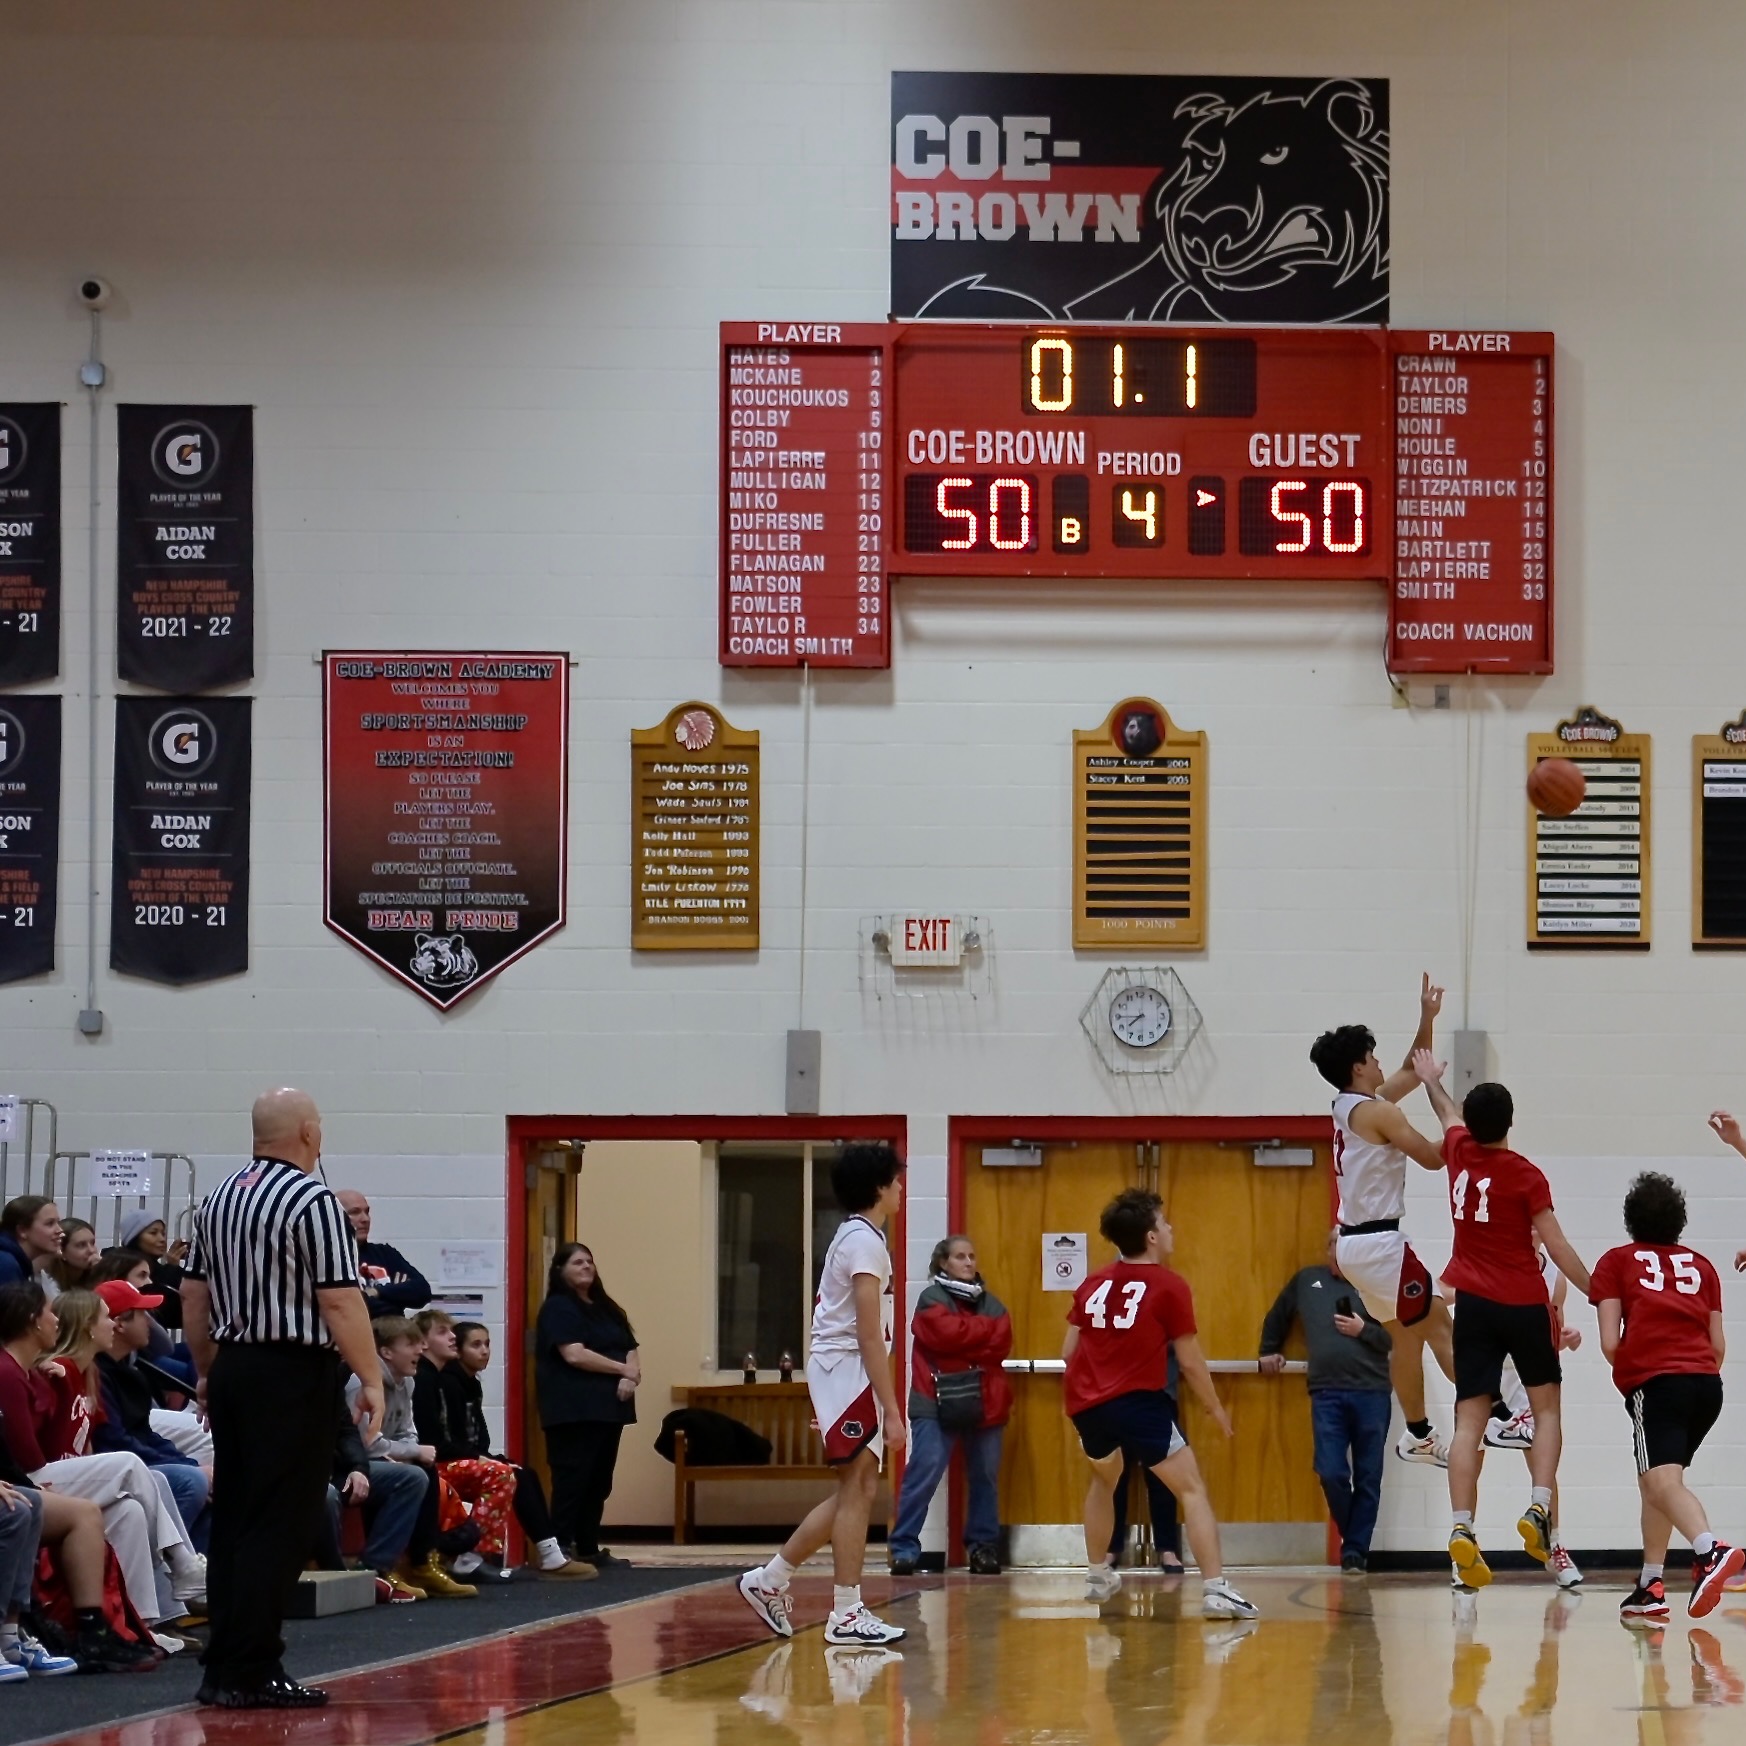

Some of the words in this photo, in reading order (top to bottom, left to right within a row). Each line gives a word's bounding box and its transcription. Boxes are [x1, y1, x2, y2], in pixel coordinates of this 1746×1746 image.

[895, 114, 1080, 181] COE-
[895, 192, 1140, 242] BROWN
[758, 325, 841, 343] PLAYER
[1428, 335, 1510, 352] PLAYER
[731, 350, 790, 365] HAYES
[1397, 357, 1456, 373] CRAWN
[1535, 358, 1541, 374] 1
[730, 369, 801, 385] MCKANE
[871, 370, 880, 386] 2
[1400, 377, 1468, 394] TAYLOR
[1535, 378, 1545, 395] 2
[731, 390, 848, 406] KOUCHOUKOS
[870, 392, 879, 407] 3
[1398, 398, 1467, 414] DEMERS
[1533, 399, 1541, 416] 3
[731, 411, 790, 428] COLBY
[871, 412, 880, 428] 5
[1398, 419, 1441, 435] NONI
[1534, 420, 1543, 435] 4
[731, 432, 777, 447] FORD
[858, 433, 880, 448] 10
[908, 430, 1085, 465] COE-BROWN
[1398, 439, 1455, 455] HOULE
[1534, 440, 1543, 457] 5
[1249, 433, 1360, 468] GUEST
[731, 452, 825, 468] LAPIERRE
[859, 453, 880, 469] 11
[1098, 452, 1181, 476] PERIOD
[1397, 460, 1467, 475] WIGGIN
[1524, 461, 1546, 477] 10
[730, 473, 826, 489] MULLIGAN
[858, 474, 880, 489] 12
[1398, 481, 1517, 496] FITZPATRICK
[1525, 482, 1544, 497] 12
[730, 493, 777, 509] MIKO
[859, 494, 880, 510] 15
[1397, 501, 1465, 517] MEEHAN
[1524, 502, 1544, 518] 14
[730, 514, 823, 531] DUFRESNE
[858, 515, 881, 531] 20
[937, 478, 1029, 550] 50
[1122, 490, 1156, 540] 4
[1271, 481, 1363, 552] 50
[156, 526, 215, 541] AIDAN
[1397, 521, 1443, 537] MAIN
[1524, 522, 1544, 538] 15
[731, 535, 801, 551] FULLER
[858, 535, 879, 551] 21
[1398, 542, 1490, 559] BARTLETT
[1523, 542, 1543, 560] 23
[165, 545, 205, 560] COX
[731, 556, 825, 572] FLANAGAN
[858, 556, 880, 572] 22
[1398, 563, 1490, 580] LAPIERRE
[1523, 563, 1544, 580] 32
[730, 576, 801, 592] MATSON
[858, 577, 880, 592] 23
[1398, 583, 1455, 599] SMITH
[1523, 584, 1544, 600] 33
[731, 597, 801, 613] FOWLER
[858, 598, 880, 613] 33
[141, 617, 187, 637] 2021
[209, 616, 231, 636] 22
[858, 618, 879, 634] 34
[1397, 623, 1454, 640] COACH
[1464, 624, 1533, 641] VACHON
[730, 638, 789, 655] COACH
[795, 638, 853, 656] SMITH
[336, 662, 452, 679] COE-BROWN
[458, 664, 554, 680] ACADEMY
[391, 683, 468, 694] WELCOMES
[472, 684, 499, 694] YOU
[422, 698, 470, 710] WHERE
[361, 714, 528, 730] SPORTSMANSHIP
[428, 736, 441, 747] IS
[445, 736, 464, 747] AN
[375, 751, 515, 768] EXPECTATION!
[1088, 758, 1118, 768] Ashley
[409, 773, 428, 784] SO
[431, 773, 480, 784] PLEASE
[662, 781, 684, 791] Joe
[1089, 774, 1117, 784] Stacey
[1124, 774, 1145, 784] Kent
[420, 788, 443, 799] LET
[446, 788, 471, 799] THE
[394, 803, 454, 814] PLAYERS
[151, 815, 210, 829] AIDAN
[419, 818, 443, 829] LET
[446, 818, 471, 829] THE
[161, 834, 200, 848] COX
[388, 833, 450, 844] COACHES
[419, 848, 443, 859] LET
[445, 848, 470, 859] THE
[372, 863, 442, 875] OFFICIALS
[419, 878, 442, 889] LET
[445, 878, 470, 889] THE
[135, 906, 184, 925] 2020
[206, 906, 225, 926] 21
[368, 910, 433, 930] BEAR
[446, 910, 519, 931] PRIDE
[1135, 920, 1176, 929] POINTS
[905, 919, 950, 951] EXIT
[1634, 1250, 1701, 1295] 35
[1084, 1280, 1147, 1329] 43
